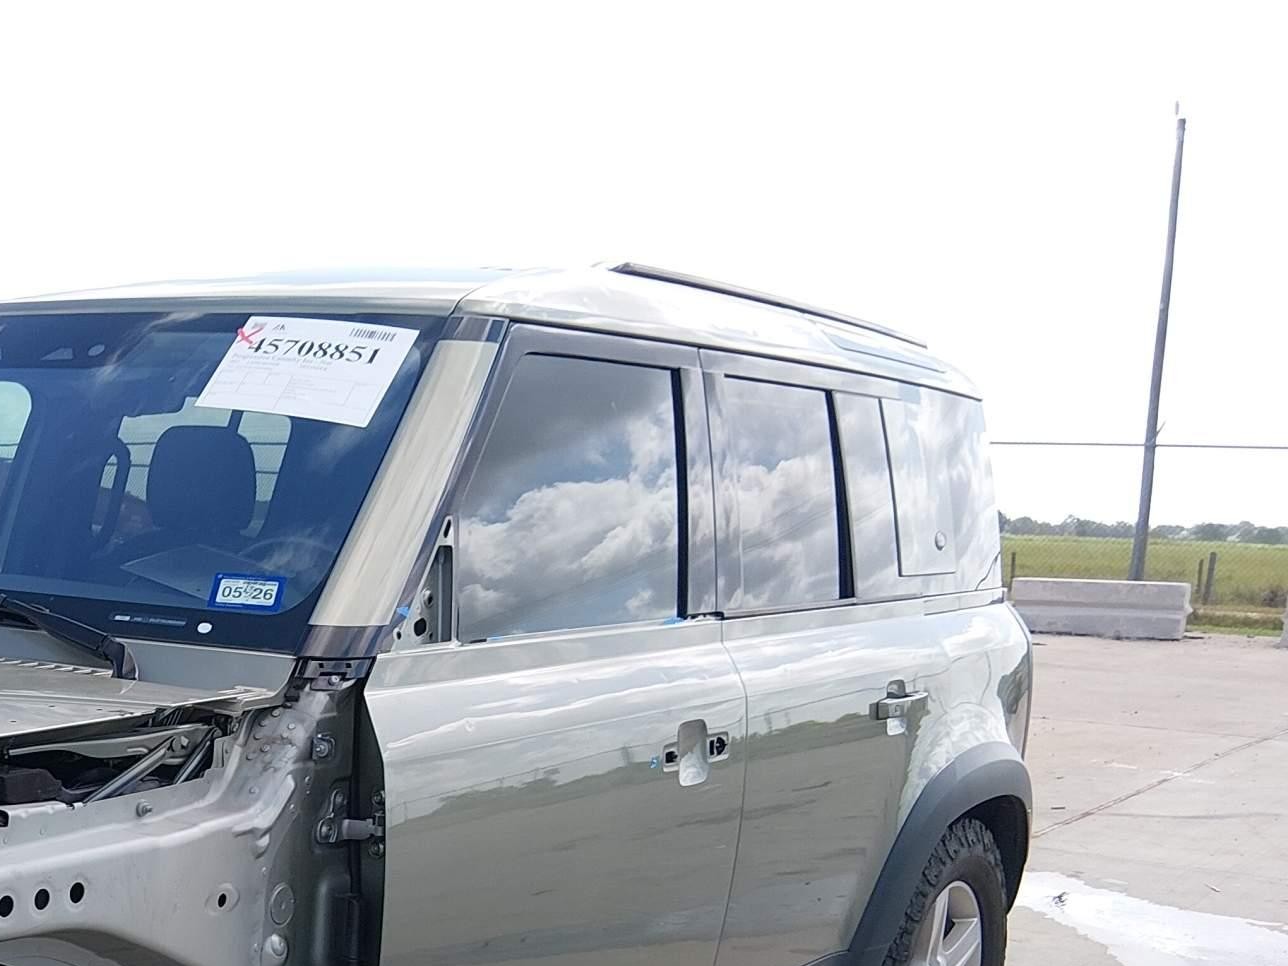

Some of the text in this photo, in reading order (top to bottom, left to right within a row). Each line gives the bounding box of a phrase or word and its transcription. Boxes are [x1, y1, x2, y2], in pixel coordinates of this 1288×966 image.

[247, 337, 382, 365] 45708851
[221, 585, 275, 601] 05 26
